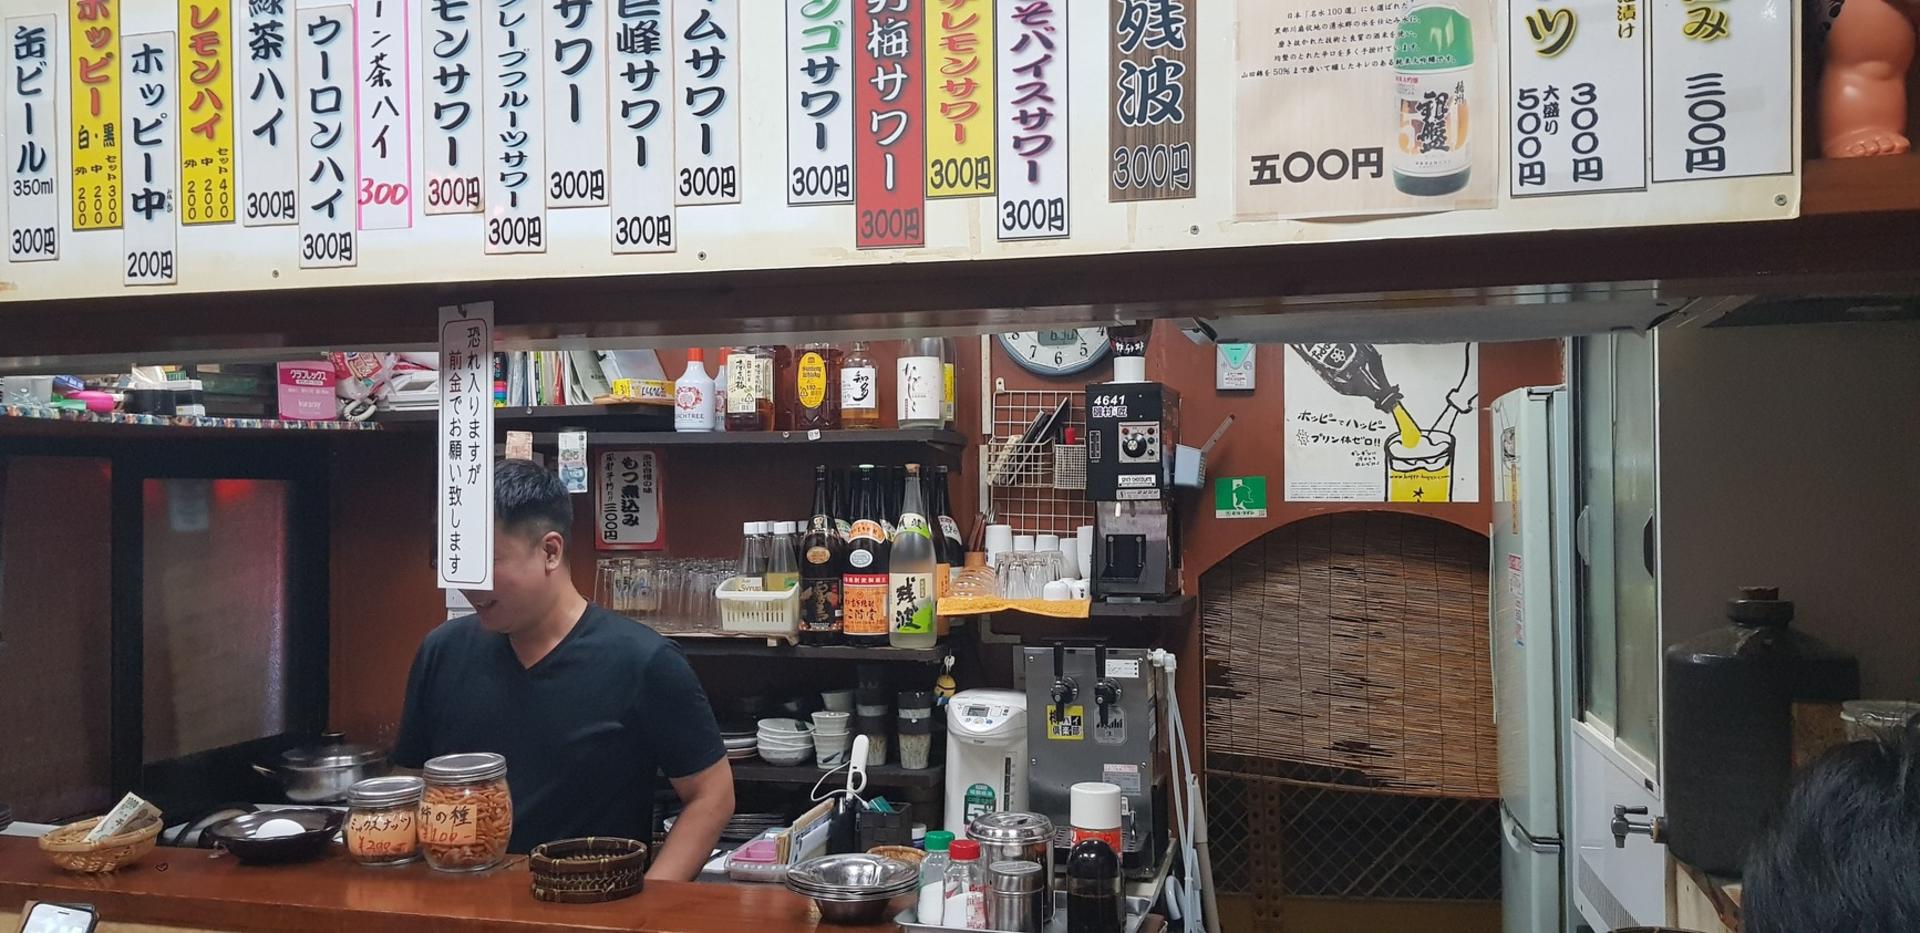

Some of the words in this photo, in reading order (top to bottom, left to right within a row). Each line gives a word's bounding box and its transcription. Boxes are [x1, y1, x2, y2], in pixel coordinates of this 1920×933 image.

[1616, 0, 1637, 39] 漬け
[188, 5, 223, 140] レモンハイ
[552, 0, 593, 123] サワー
[683, 0, 727, 156] ムサワー
[1116, 0, 1187, 127] 残波
[13, 25, 47, 174] 缶ビール
[433, 0, 471, 167] モンサワー
[616, 0, 661, 167] 巨峰サワー
[1010, 0, 1055, 184] そバイスサワー
[308, 15, 344, 219] ウーロンハイ
[1541, 84, 1560, 137] 大盛り
[131, 43, 167, 220] ホッピー中
[1516, 86, 1546, 188] 500円
[1571, 81, 1605, 185] 300円
[680, 165, 737, 198] 300円
[792, 164, 850, 198] 300円
[930, 156, 991, 190] 300円
[1112, 142, 1192, 191] 300円
[12, 177, 54, 198] 350ml
[357, 177, 408, 207] 300
[428, 176, 481, 207] 300円
[550, 169, 605, 201] 300円
[247, 191, 295, 220] 300円
[1002, 197, 1065, 232] 300円
[488, 216, 542, 247] 300円
[616, 215, 672, 247] 300円
[861, 206, 920, 240] 300円
[12, 226, 55, 256] 300円
[302, 231, 353, 261] 300円
[127, 250, 173, 279] 200円
[1029, 345, 1038, 359] 7
[1054, 351, 1063, 365] 6
[1079, 343, 1088, 356] 5
[852, 370, 870, 402] 知多
[1093, 394, 1126, 406] 4641
[466, 326, 481, 487] 恐れ入りますが
[1297, 409, 1387, 432] ホッピーでハッピー
[448, 350, 463, 574] 前金でお願い致します
[621, 456, 640, 527] もつ煮込み
[895, 576, 922, 630] 残波
[350, 815, 412, 832] ミックスナッツ
[420, 804, 473, 828] 柿の種
